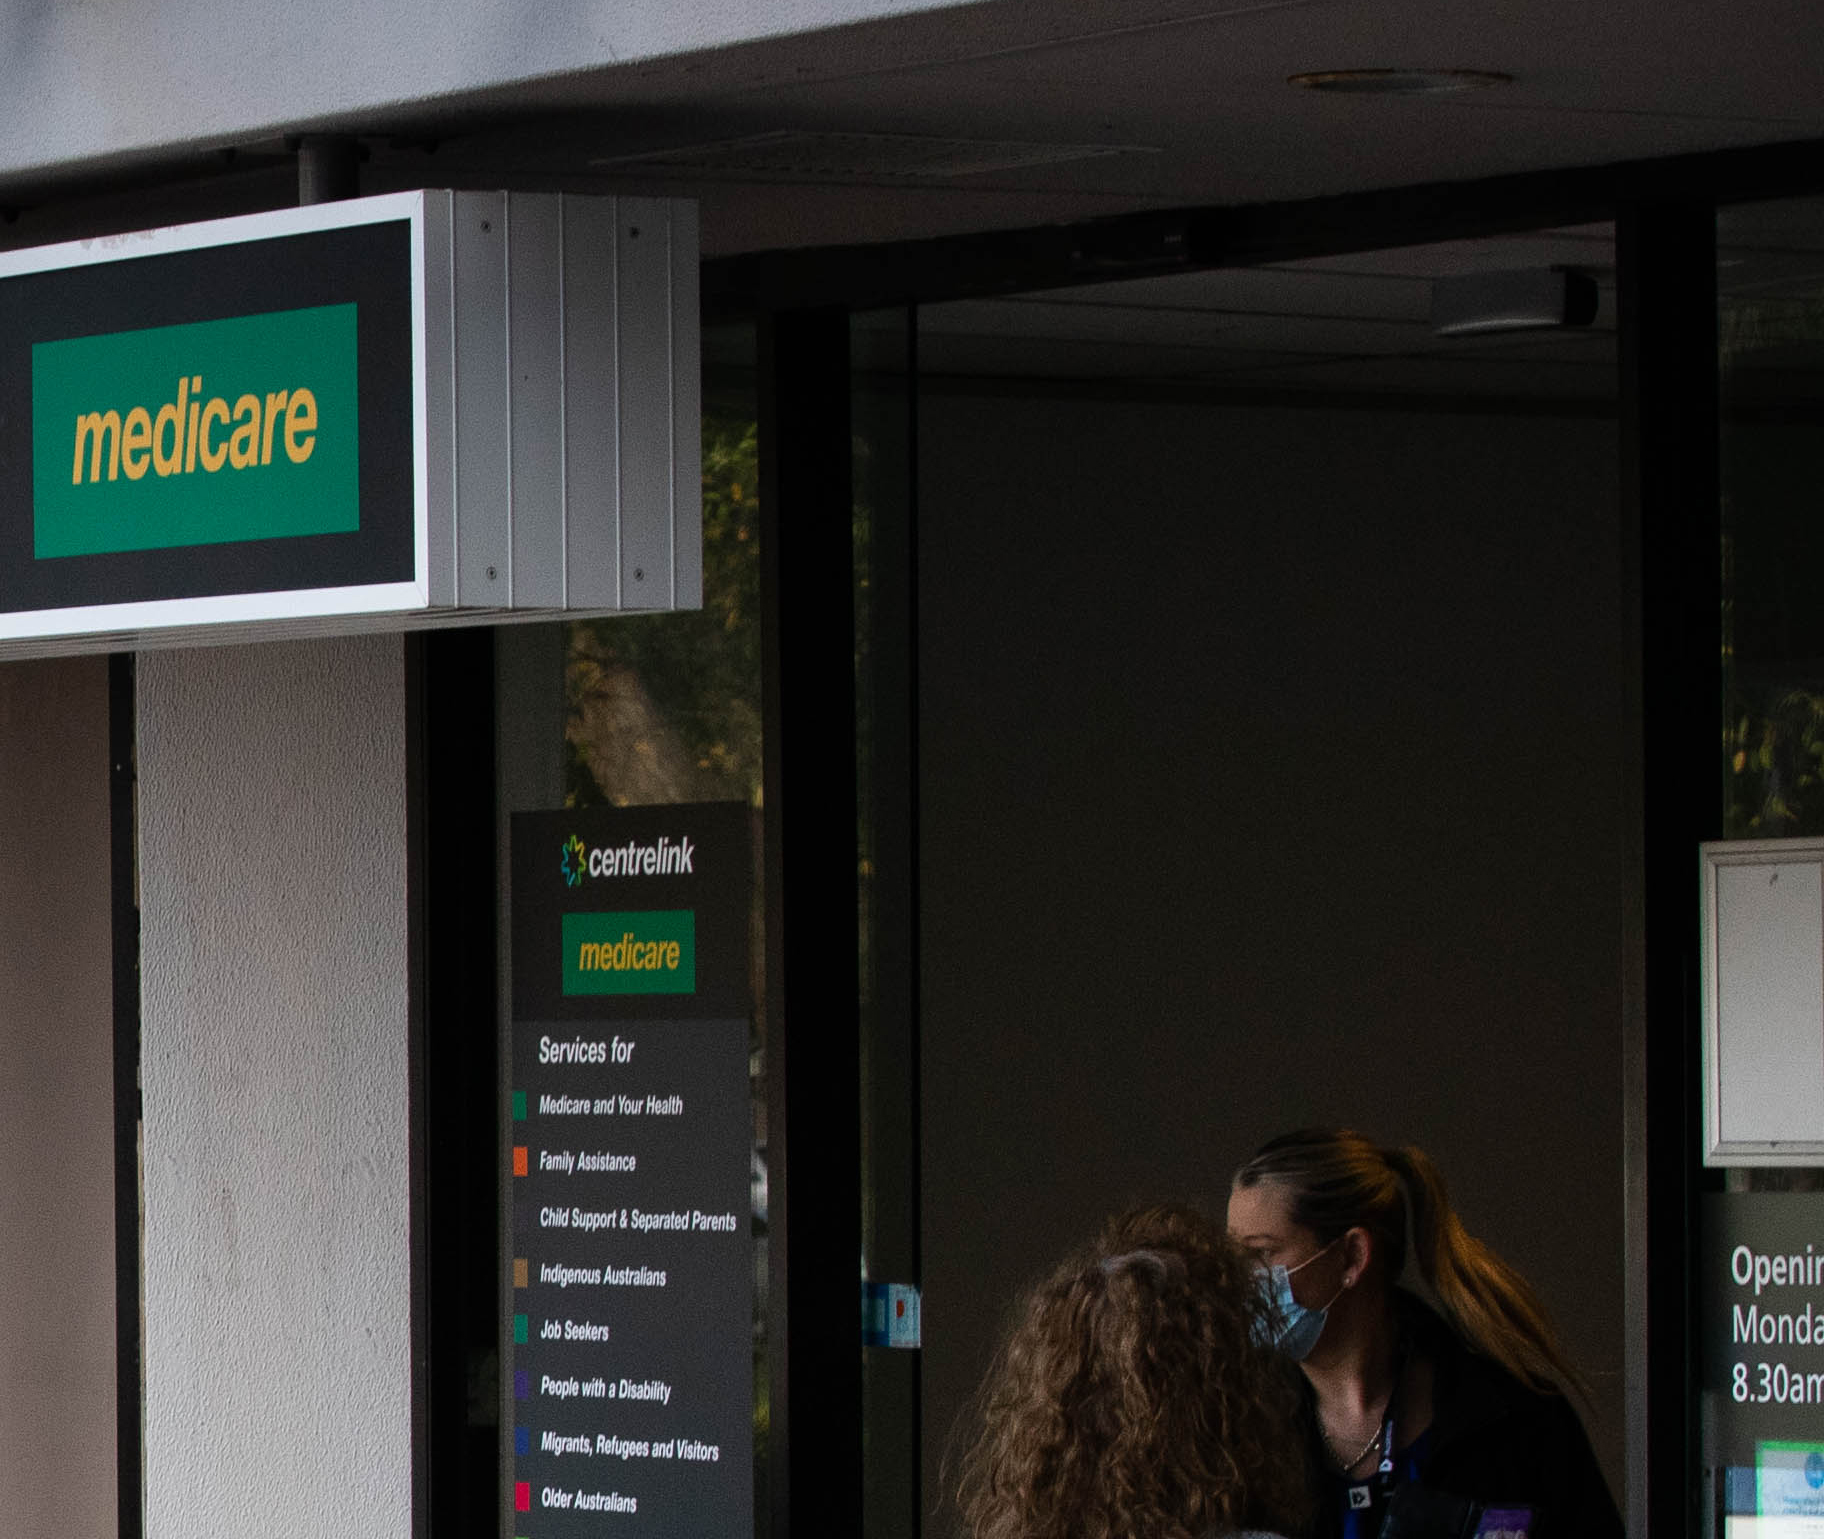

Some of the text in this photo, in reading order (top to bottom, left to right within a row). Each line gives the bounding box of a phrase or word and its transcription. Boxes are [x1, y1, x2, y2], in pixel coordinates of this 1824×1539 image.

[72, 375, 318, 486] medicare
[588, 836, 694, 877] centrelink
[579, 933, 680, 971] medicare
[539, 1036, 634, 1063] Services for
[540, 1095, 683, 1115] Medicare and Your Health
[540, 1151, 636, 1175] Family Assistance
[541, 1207, 736, 1233] Child Support & Separated Parents
[541, 1263, 666, 1287] Indigenous Australians
[541, 1320, 608, 1341] Job Seekers
[541, 1376, 671, 1405] People with a Disability
[541, 1431, 719, 1461] Migrants, Refugees and Visitors
[542, 1487, 636, 1513] Older Australians
